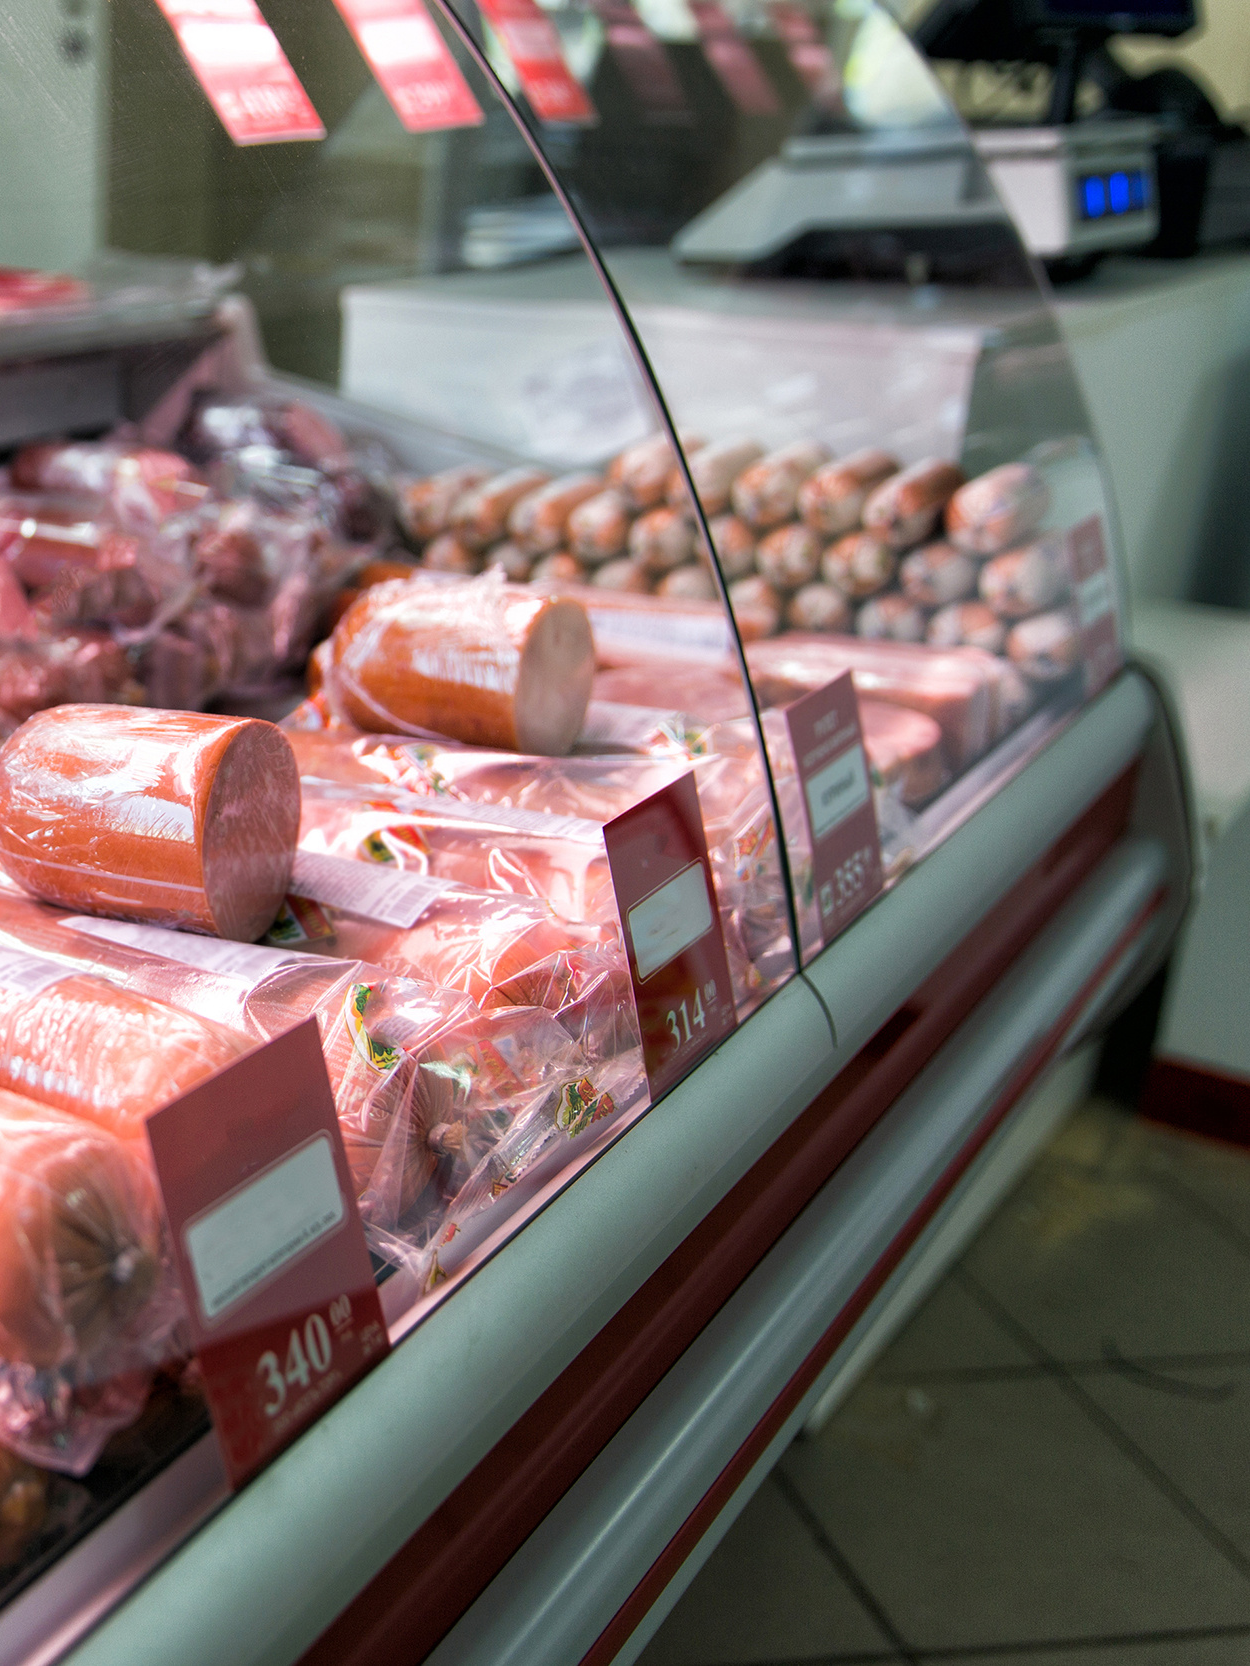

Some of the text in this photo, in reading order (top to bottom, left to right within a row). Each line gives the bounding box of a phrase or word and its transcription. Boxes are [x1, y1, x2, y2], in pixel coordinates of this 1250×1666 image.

[665, 987, 706, 1054] 314
[255, 1312, 333, 1418] 340
[328, 1293, 352, 1327] 00
